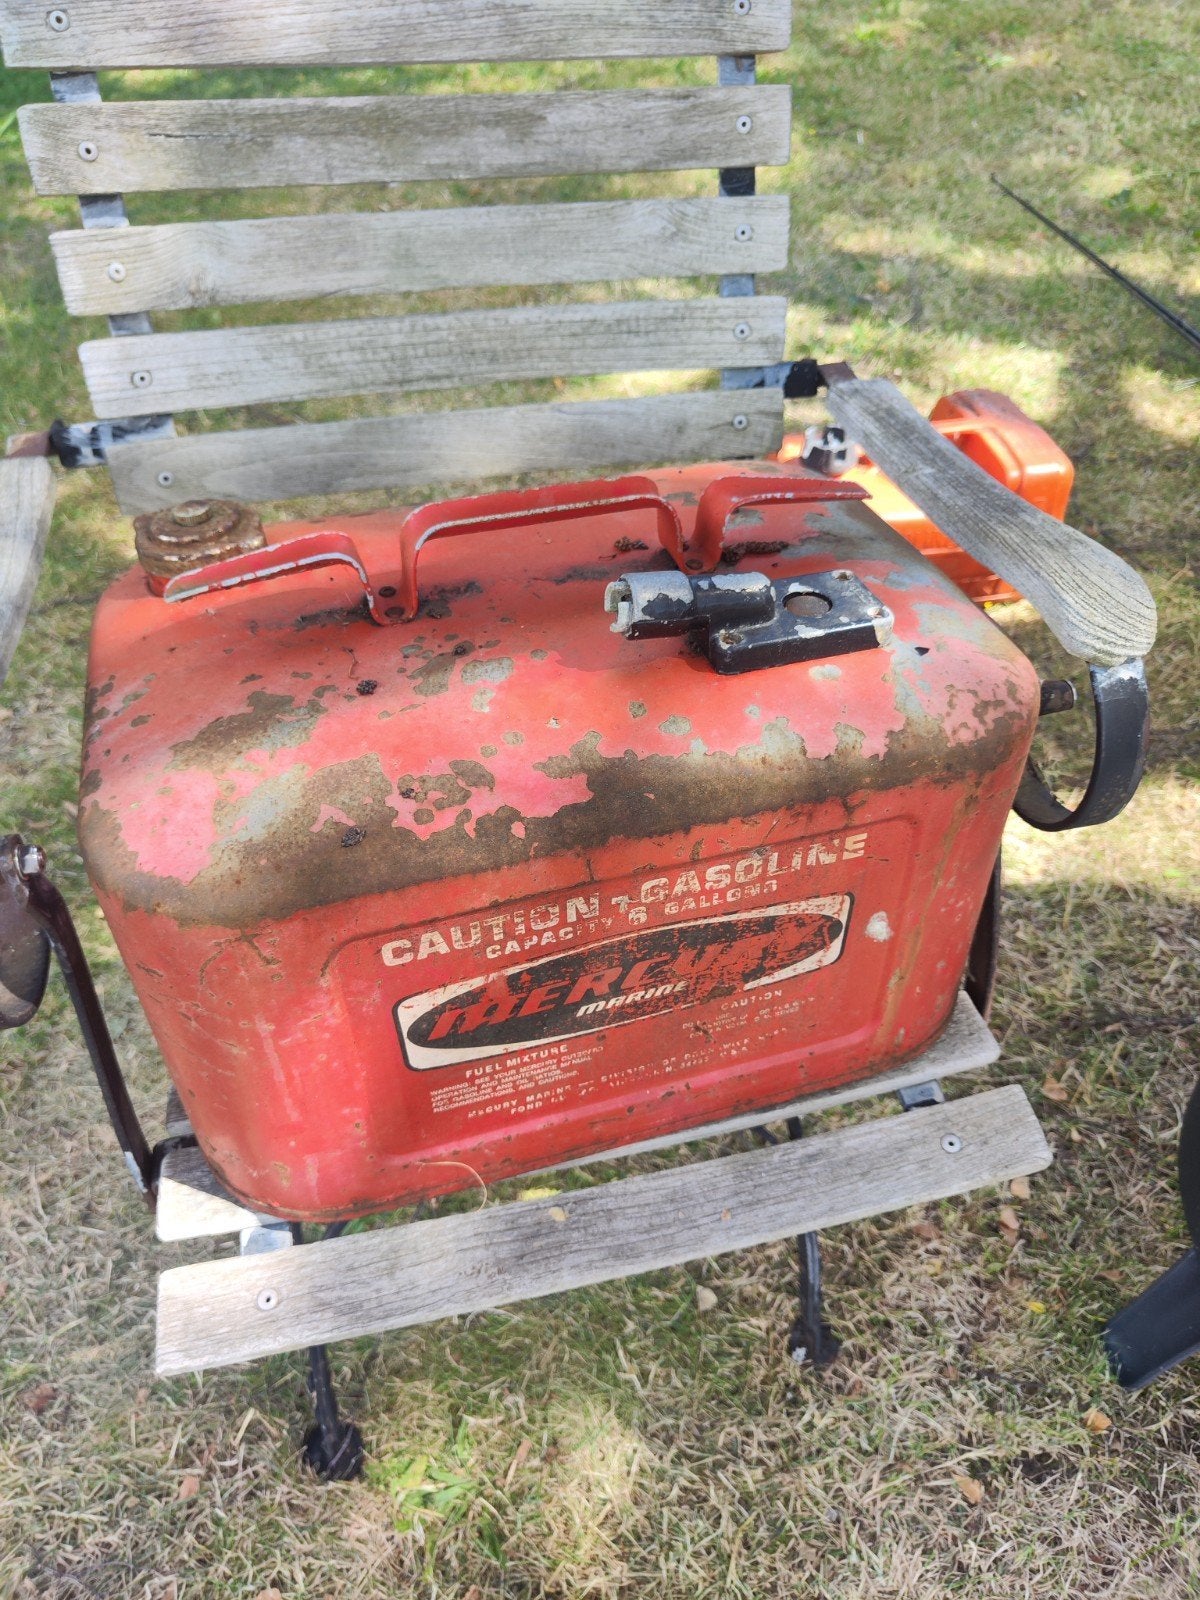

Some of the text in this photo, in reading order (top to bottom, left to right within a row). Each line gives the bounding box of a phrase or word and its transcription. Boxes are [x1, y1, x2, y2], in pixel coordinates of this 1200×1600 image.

[381, 833, 868, 967] CAUTION GASOLINE
[628, 906, 648, 926] 6
[665, 879, 778, 915] GALLONS
[721, 990, 783, 1011] CAUTION
[465, 1044, 569, 1079] FUEL MIXTURE
[480, 1080, 499, 1089] AND
[495, 1081, 514, 1091] AND
[518, 1081, 536, 1091] AND
[510, 1100, 544, 1115] FOND
